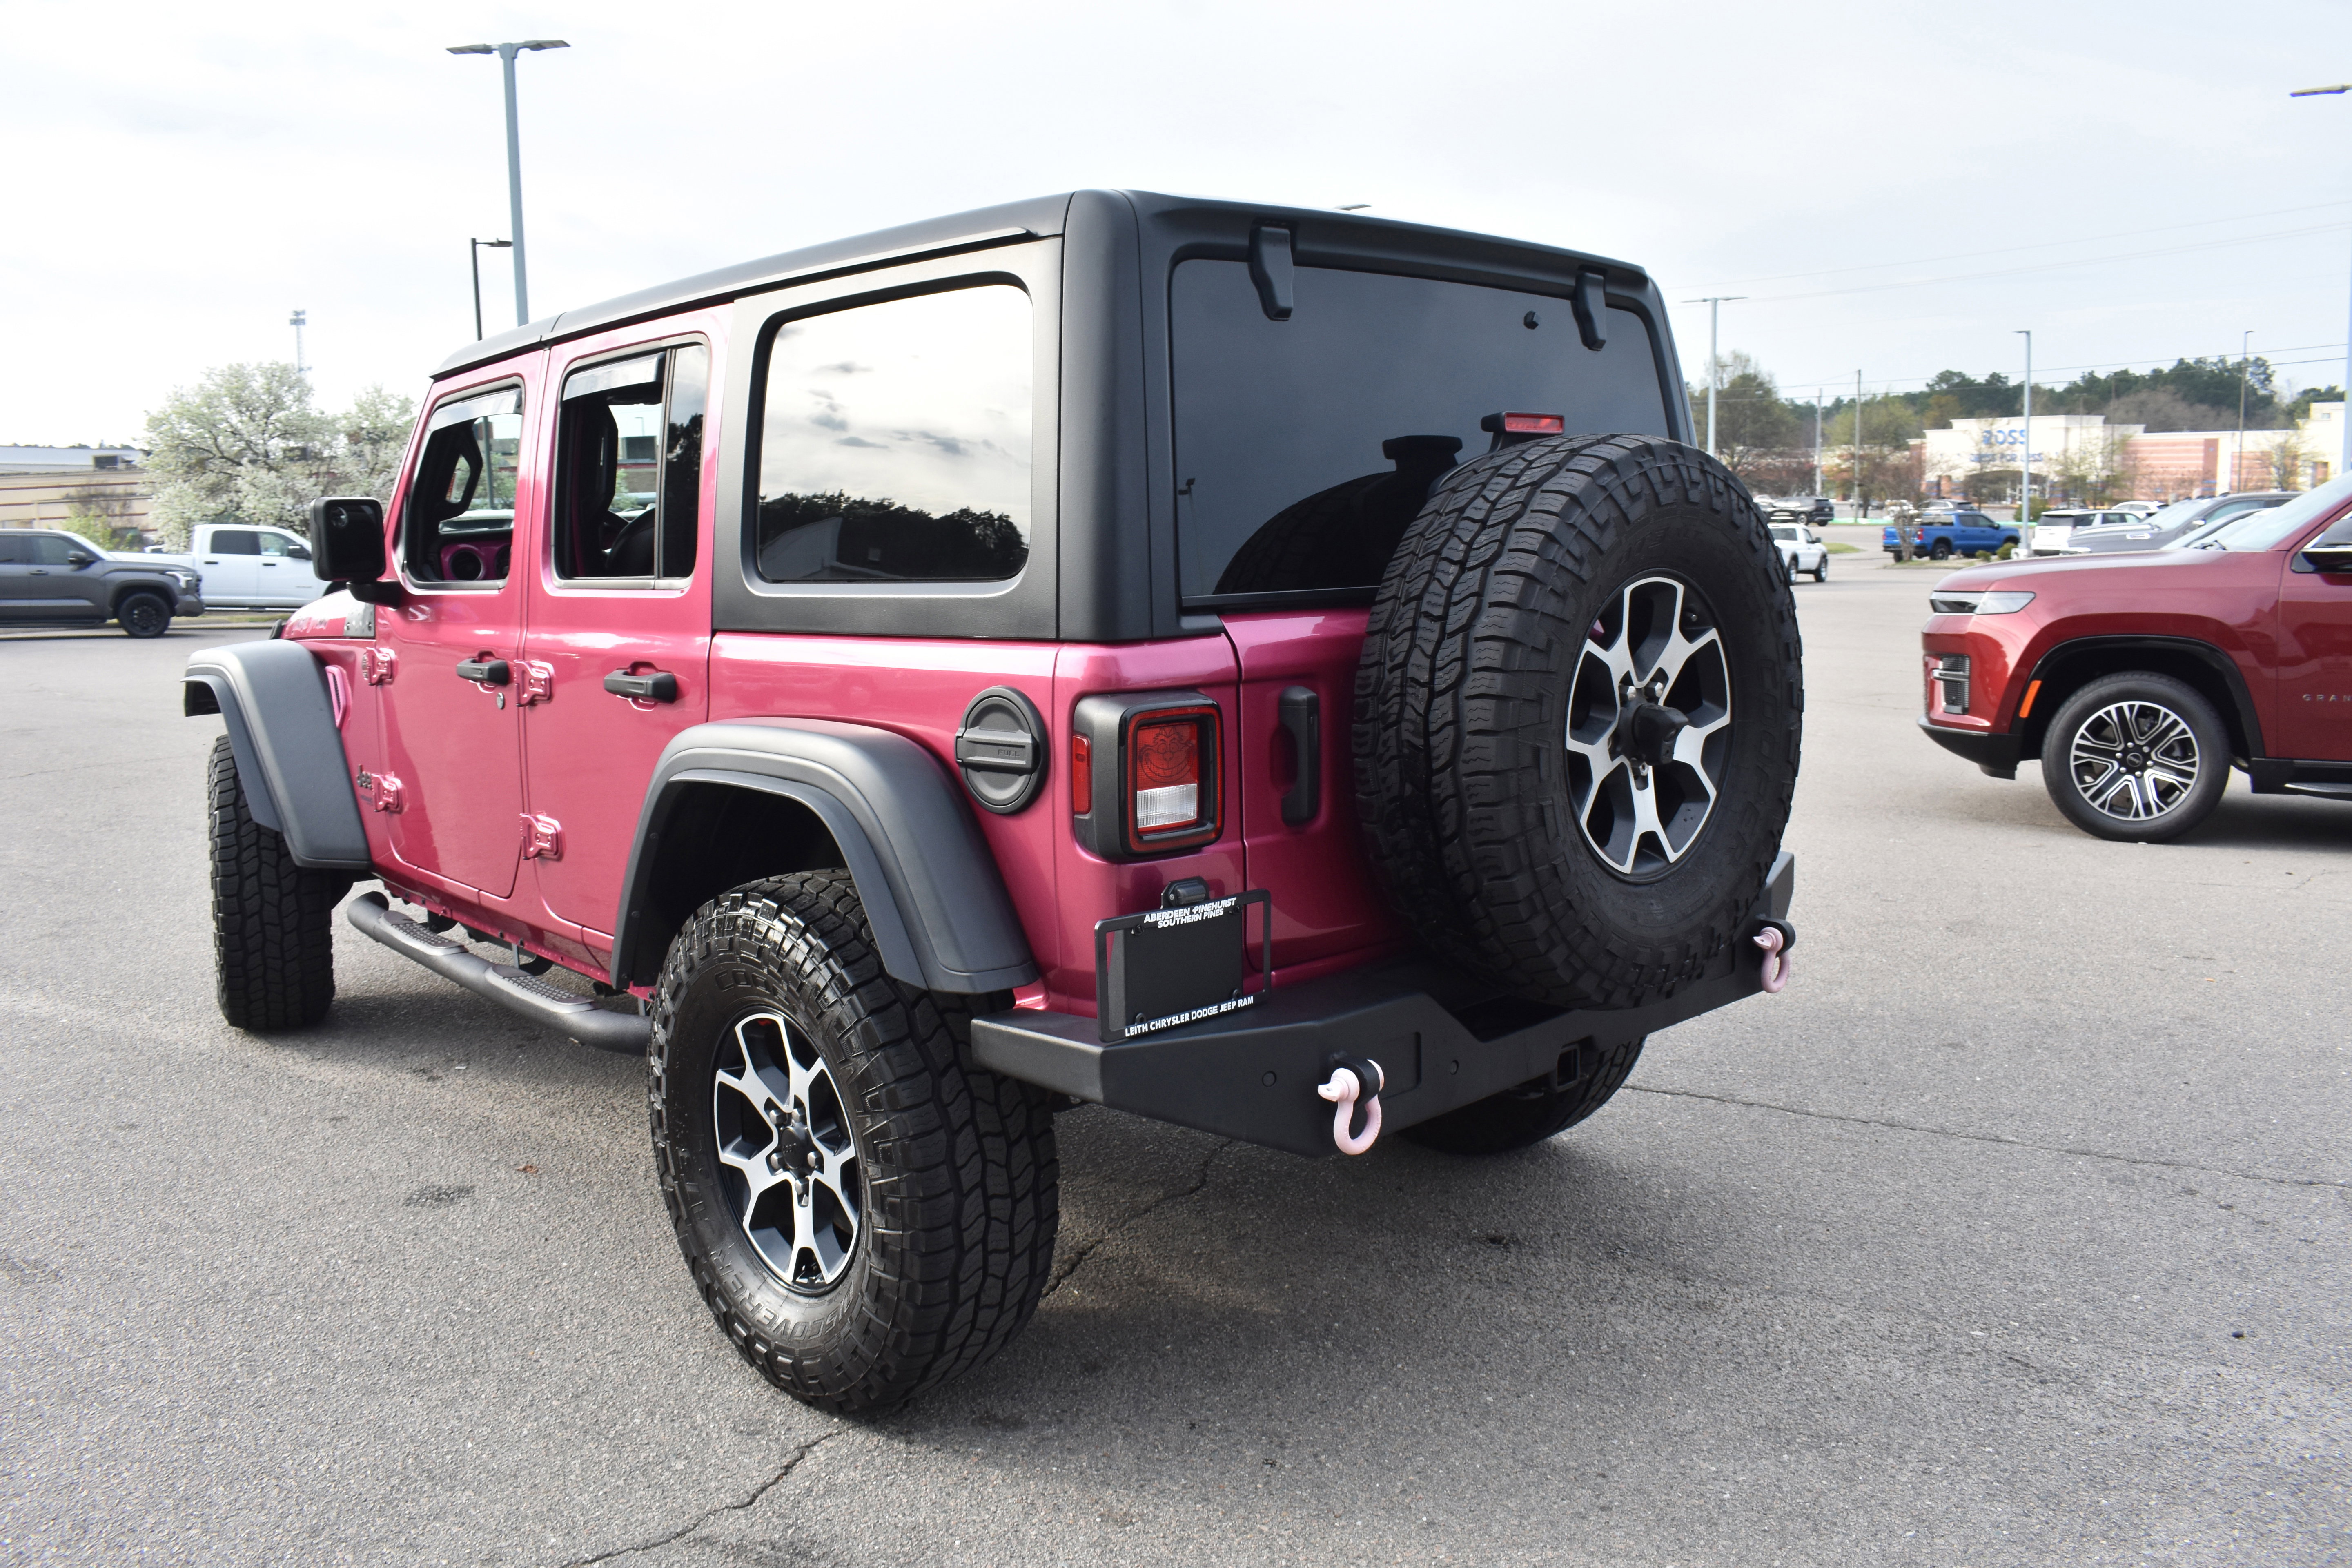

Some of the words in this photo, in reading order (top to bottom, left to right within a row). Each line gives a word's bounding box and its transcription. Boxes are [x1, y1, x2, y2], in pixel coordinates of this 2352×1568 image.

[998, 749, 1020, 757] FUEL
[1144, 907, 1190, 923] ABERDEEN
[1158, 913, 1202, 928] SOUTHERN
[1203, 908, 1224, 920] PINES
[1125, 1023, 1148, 1037] LEITH
[1150, 1013, 1190, 1030] CHRYSLER
[1191, 1005, 1218, 1020] DODGE
[1220, 1000, 1236, 1013] JEEP
[1238, 996, 1254, 1007] RAM
